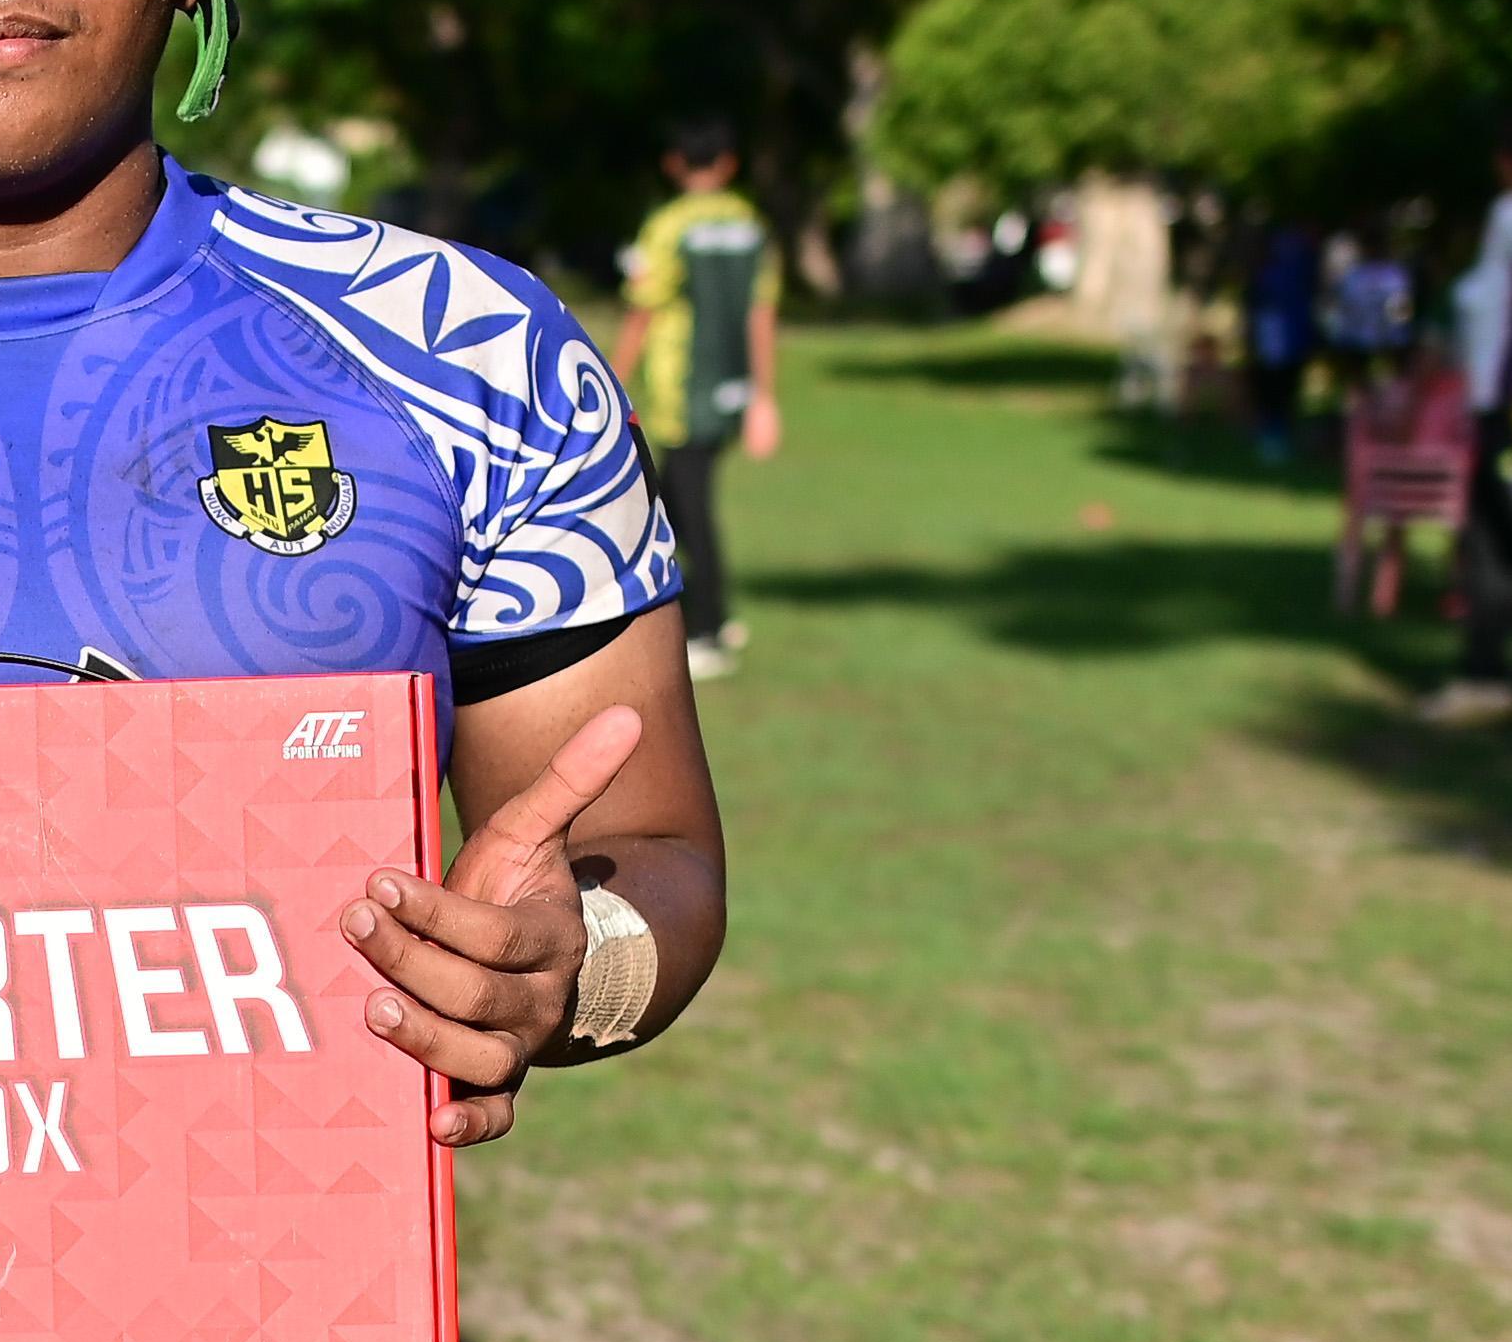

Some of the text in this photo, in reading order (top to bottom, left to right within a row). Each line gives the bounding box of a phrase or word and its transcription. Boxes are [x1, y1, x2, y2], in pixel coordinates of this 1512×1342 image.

[242, 468, 316, 519] HS
[204, 476, 352, 552] NUNC AUT NUNQUAM
[287, 504, 318, 533] PAHAT
[282, 710, 366, 746] ATF
[282, 744, 363, 760] SPORT TAPING
